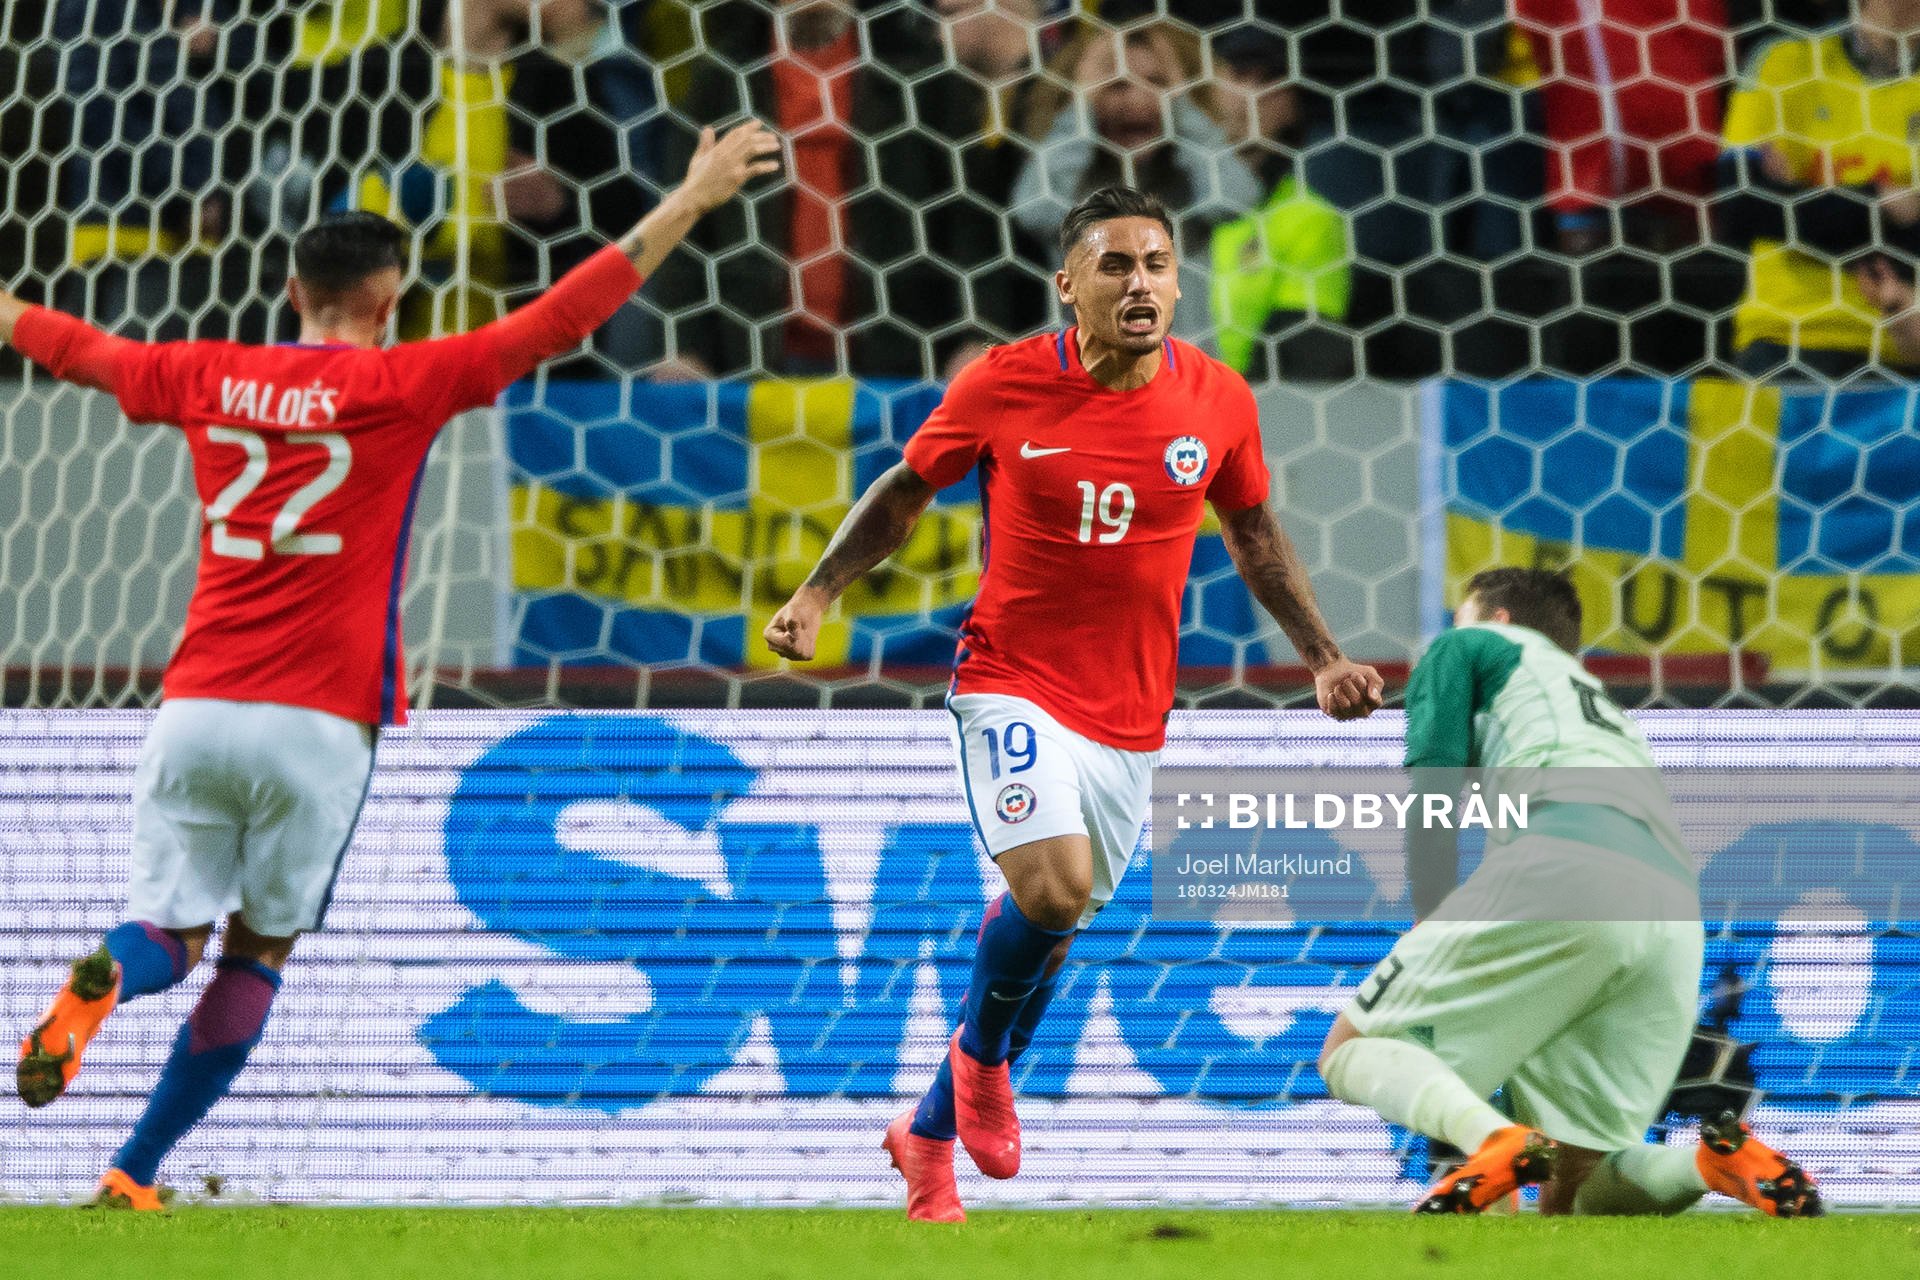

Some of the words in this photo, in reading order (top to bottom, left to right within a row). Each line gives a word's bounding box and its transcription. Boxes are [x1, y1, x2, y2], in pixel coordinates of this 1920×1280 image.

[206, 425, 353, 560] 22
[1077, 480, 1136, 544] 19
[982, 722, 1037, 780] 19
